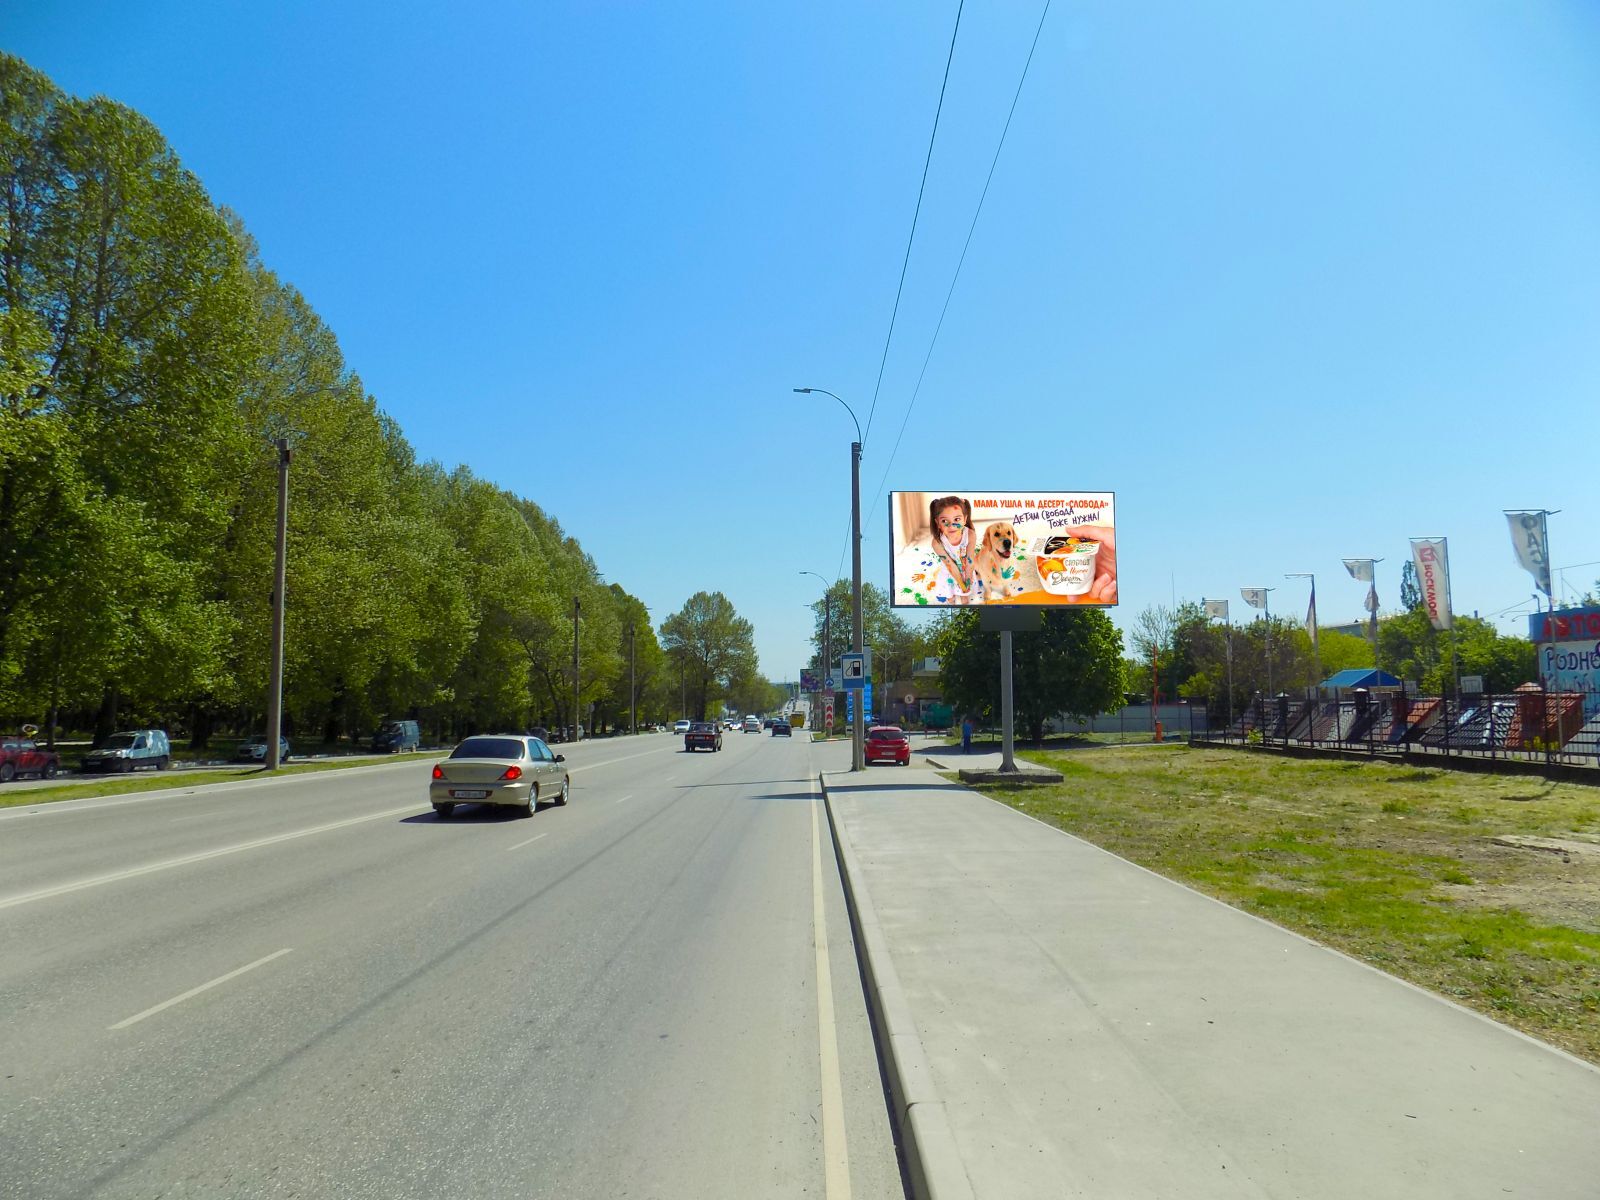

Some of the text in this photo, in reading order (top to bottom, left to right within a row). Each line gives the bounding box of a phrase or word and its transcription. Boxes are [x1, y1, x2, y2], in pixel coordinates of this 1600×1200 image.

[974, 500, 998, 508] МАМА
[1000, 500, 1022, 508] УШЛА
[1025, 500, 1035, 508] НА
[1038, 500, 1064, 509] ДЕСЕРТ
[1013, 511, 1040, 525] ДЕТЯМ
